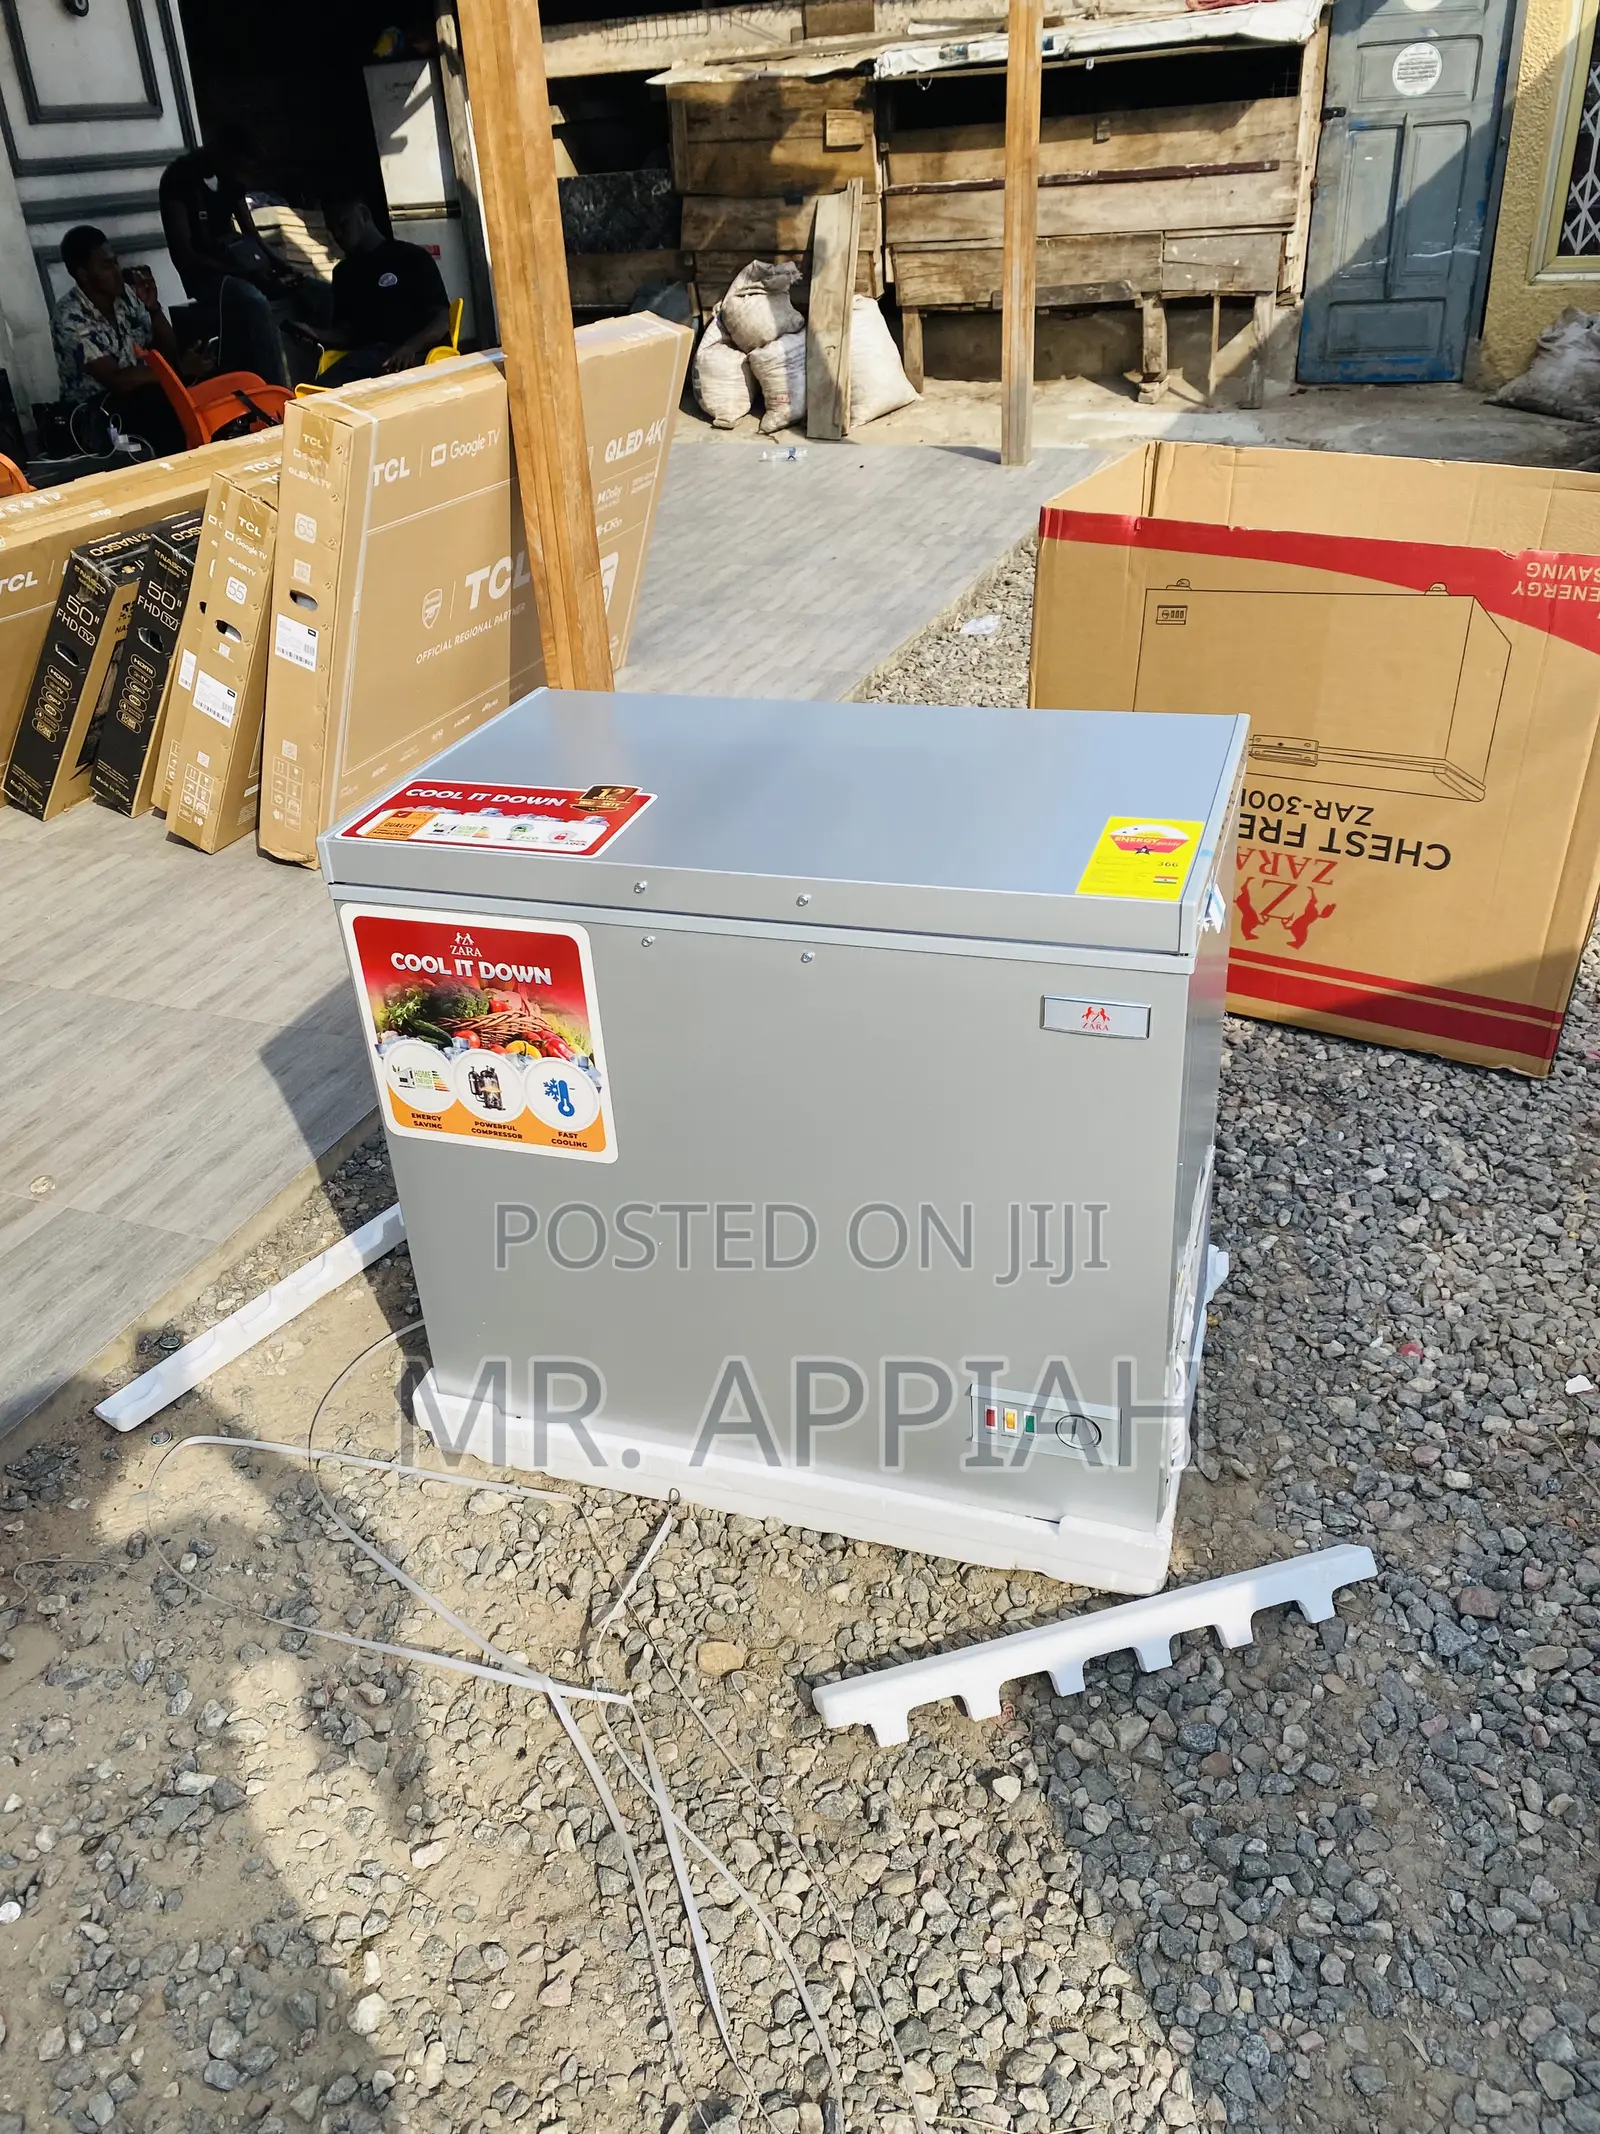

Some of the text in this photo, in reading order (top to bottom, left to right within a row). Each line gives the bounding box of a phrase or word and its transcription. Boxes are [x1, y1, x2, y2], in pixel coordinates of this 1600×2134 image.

[303, 433, 324, 449] TCL
[450, 428, 500, 459] Google TV
[604, 417, 667, 463] QLED 4K
[243, 460, 273, 474] TCL
[373, 456, 411, 486] TCL
[260, 474, 281, 485] TC
[319, 478, 332, 490] TV
[171, 525, 202, 542] SCO
[238, 516, 262, 538] TCL
[296, 515, 316, 540] 65
[90, 534, 141, 558] NASCO
[235, 537, 268, 561] Google TV
[158, 549, 188, 577] NASCO
[0, 571, 38, 596] TCL
[228, 579, 246, 601] 55
[465, 550, 531, 611] TCL
[1511, 580, 1600, 602] ENERGY
[136, 594, 161, 618] FHD
[146, 579, 183, 612] 50"
[55, 607, 79, 632] FHD
[65, 594, 100, 627] 50"
[416, 602, 526, 664] OFFICIAL REGIONAL PARTNER
[404, 788, 567, 806] COOL IT DOWN
[598, 787, 626, 798] 12
[1114, 836, 1160, 845] ENERGY
[1318, 827, 1452, 871] CHEST
[1236, 846, 1338, 885] ZARA
[450, 944, 483, 958] ZARA
[390, 952, 553, 985] COOL IT DOWN
[1081, 1022, 1110, 1032] ZARA
[411, 1112, 442, 1122] ENERGY
[413, 1120, 443, 1130] SAVING
[474, 1120, 517, 1132] POWERFUL
[470, 1127, 523, 1140] COMPRESSOR
[551, 1138, 588, 1149] COOLING
[558, 1131, 579, 1139] FAST
